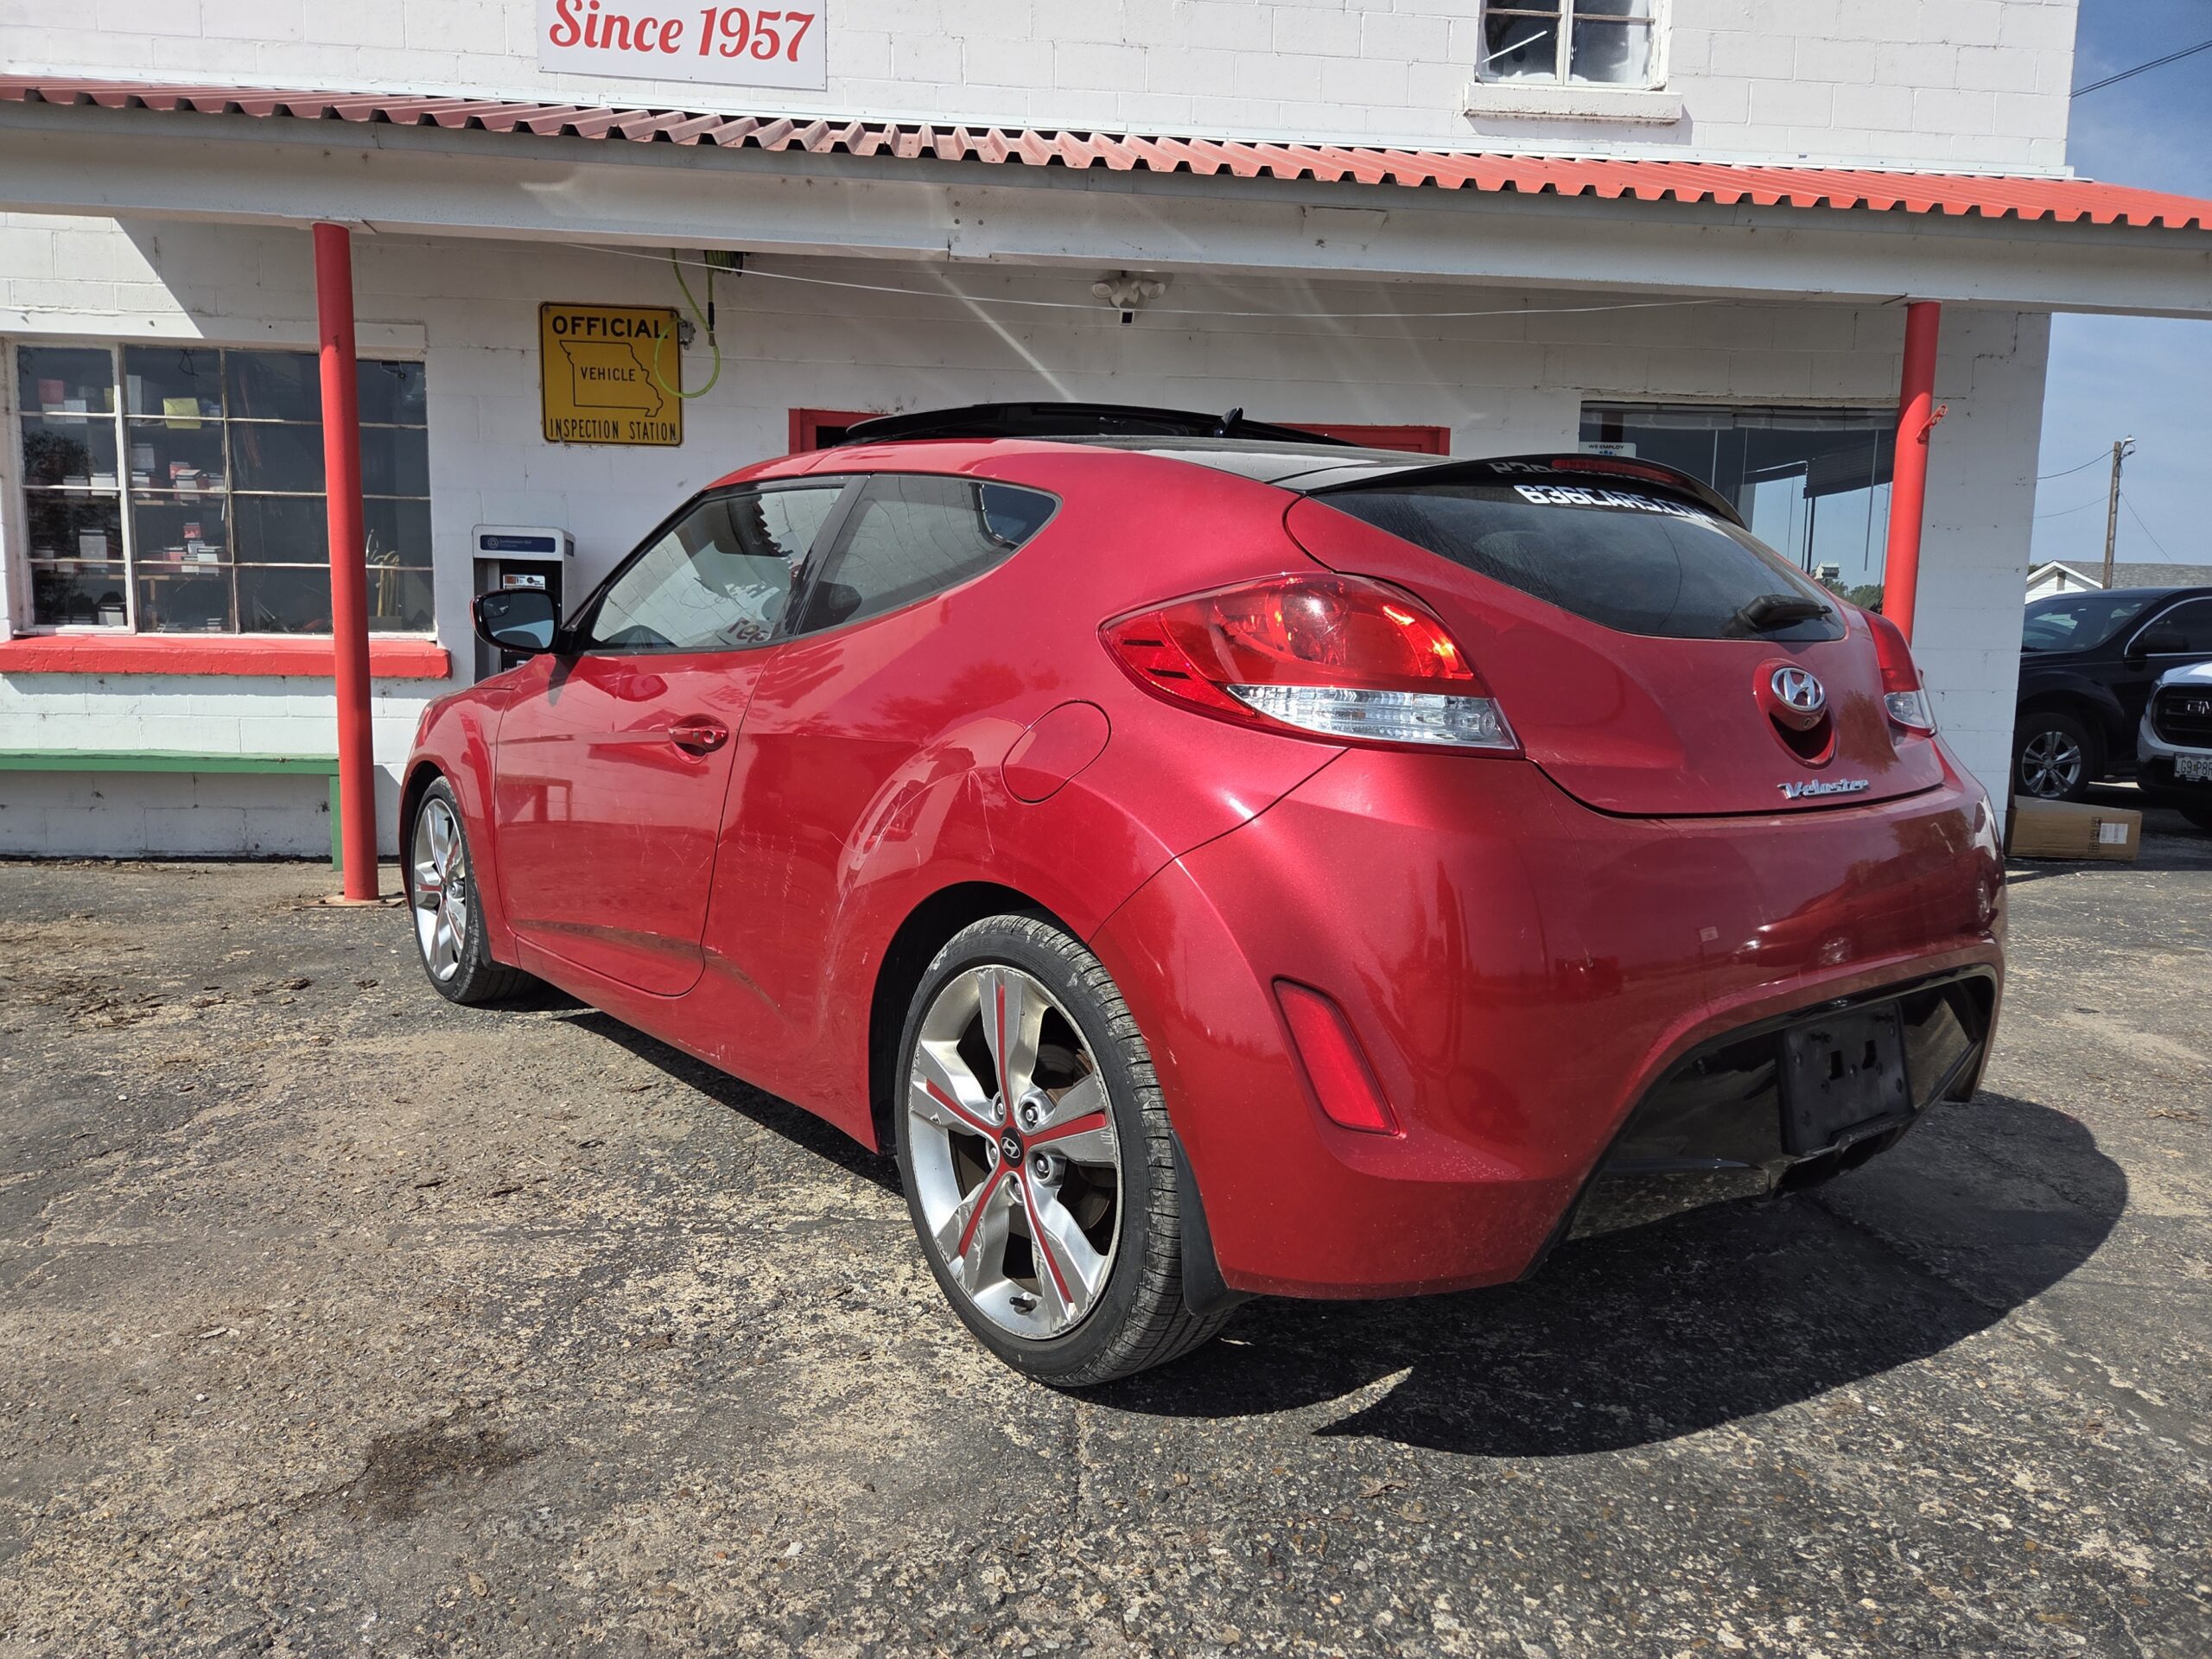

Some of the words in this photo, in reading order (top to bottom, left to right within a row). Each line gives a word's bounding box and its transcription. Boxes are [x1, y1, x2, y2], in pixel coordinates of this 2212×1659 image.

[549, 0, 683, 54] Since
[698, 6, 815, 62] 1957
[552, 315, 668, 339] OFFICIAL
[581, 366, 636, 382] VEHICLE
[550, 418, 619, 439] INSPECTION
[629, 422, 677, 441] STATION
[1777, 779, 1869, 799] Veloster
